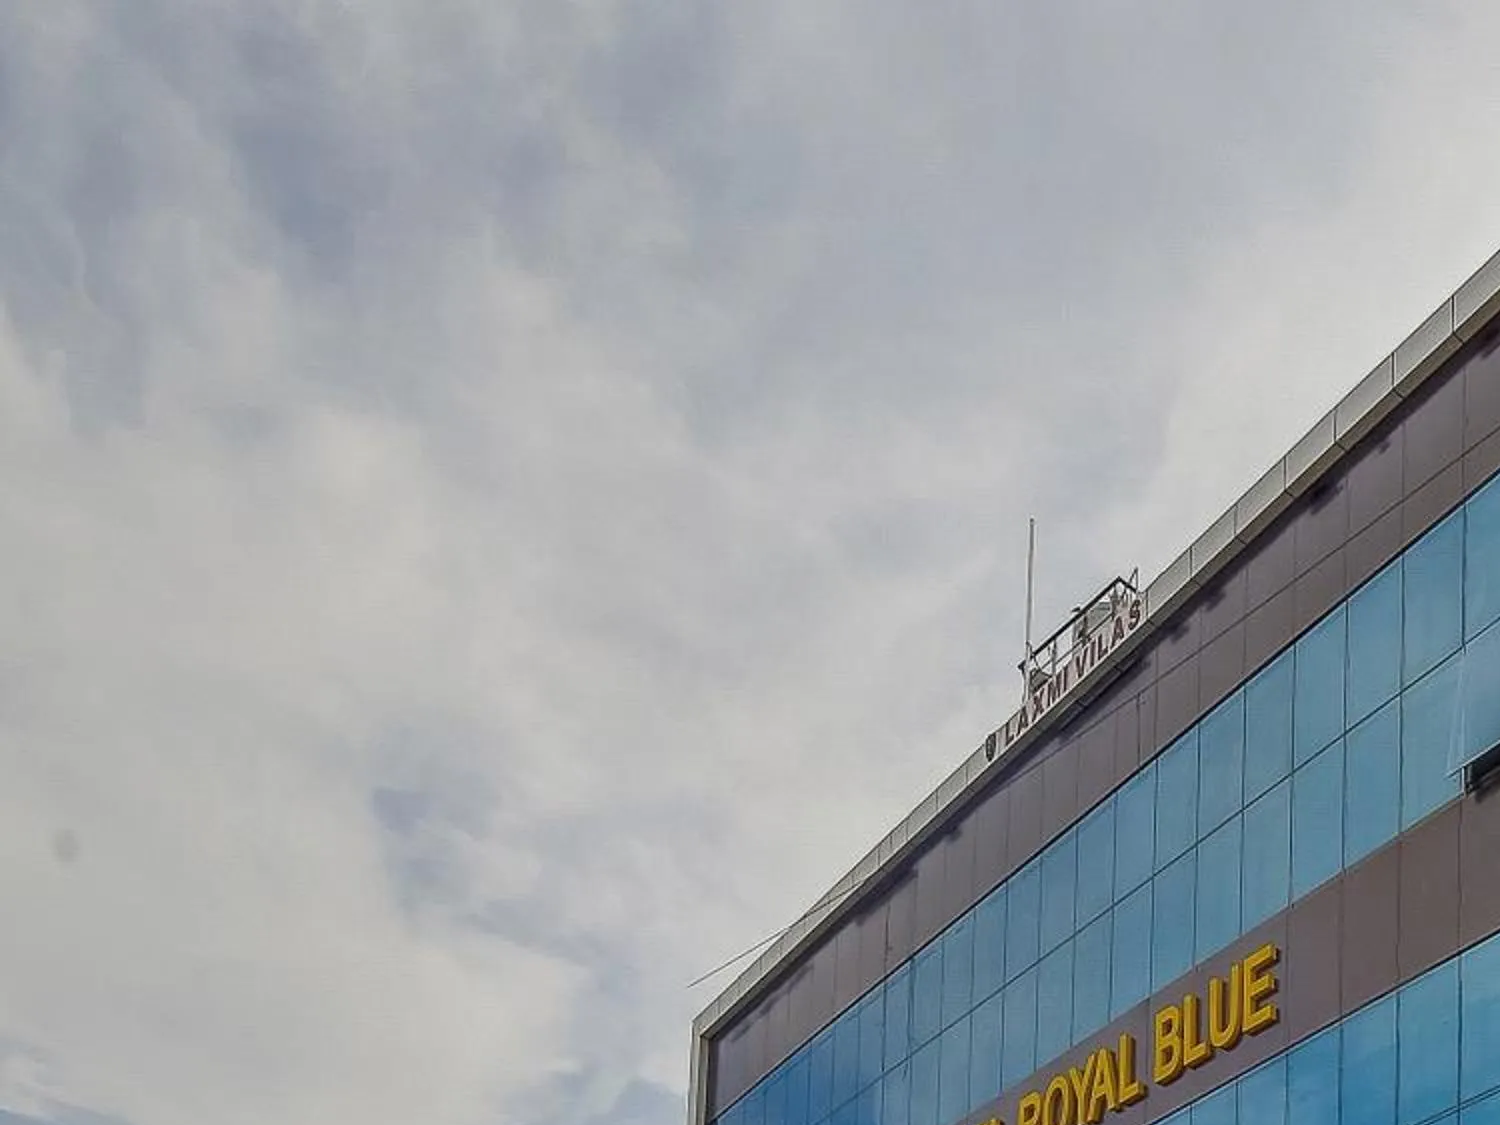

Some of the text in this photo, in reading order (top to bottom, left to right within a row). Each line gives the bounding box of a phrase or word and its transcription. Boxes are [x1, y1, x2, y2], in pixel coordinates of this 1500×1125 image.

[1005, 599, 1141, 746] LAXMI VILAS
[1153, 942, 1280, 1086] BLUE
